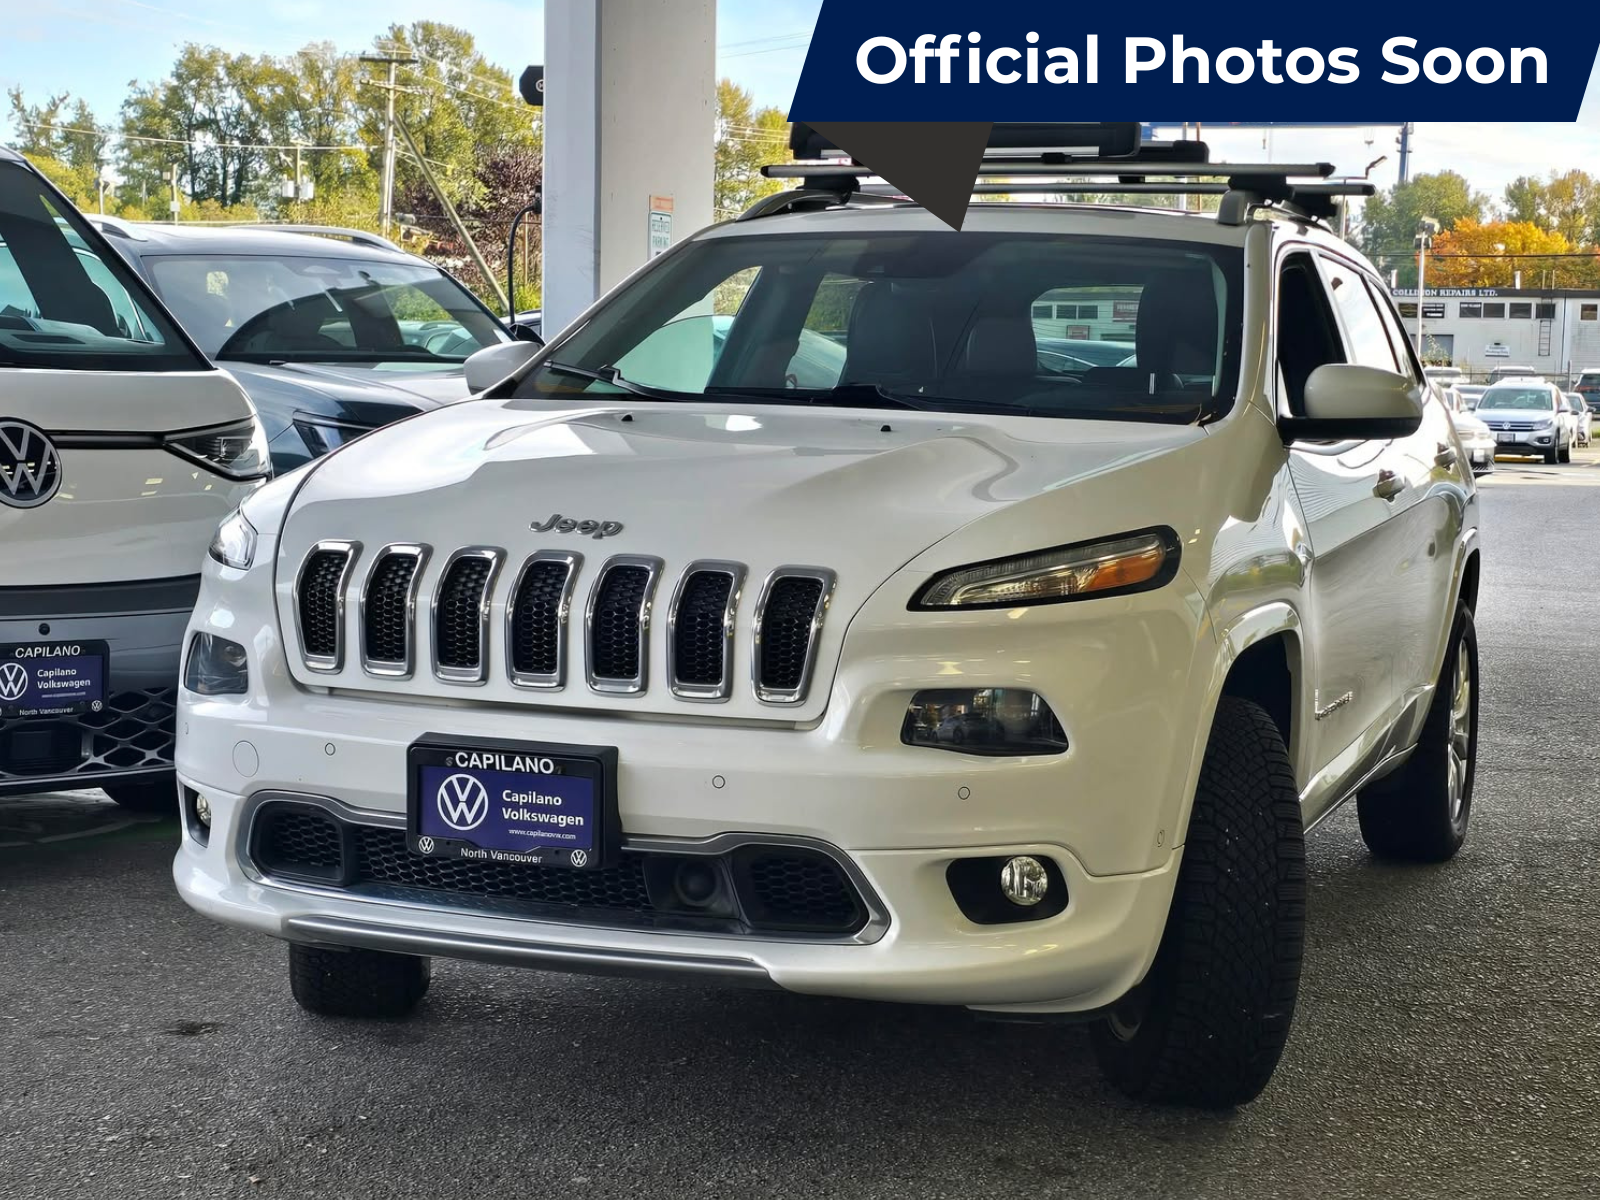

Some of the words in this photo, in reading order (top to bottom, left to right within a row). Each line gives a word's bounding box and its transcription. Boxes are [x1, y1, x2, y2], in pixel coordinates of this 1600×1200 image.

[1439, 288, 1476, 296] REPAIRS
[1478, 288, 1498, 297] LTD.
[529, 513, 624, 539] Jeep
[15, 645, 81, 658] CAPILANO
[37, 668, 77, 678] Capilano
[37, 680, 91, 689] Volkswagen
[39, 707, 73, 715] Vancouver
[455, 752, 555, 774] CAPILANO
[502, 790, 563, 806] Capilano
[502, 807, 584, 827] Volkswagen
[460, 848, 488, 859] North
[490, 849, 543, 864] Vancouver
